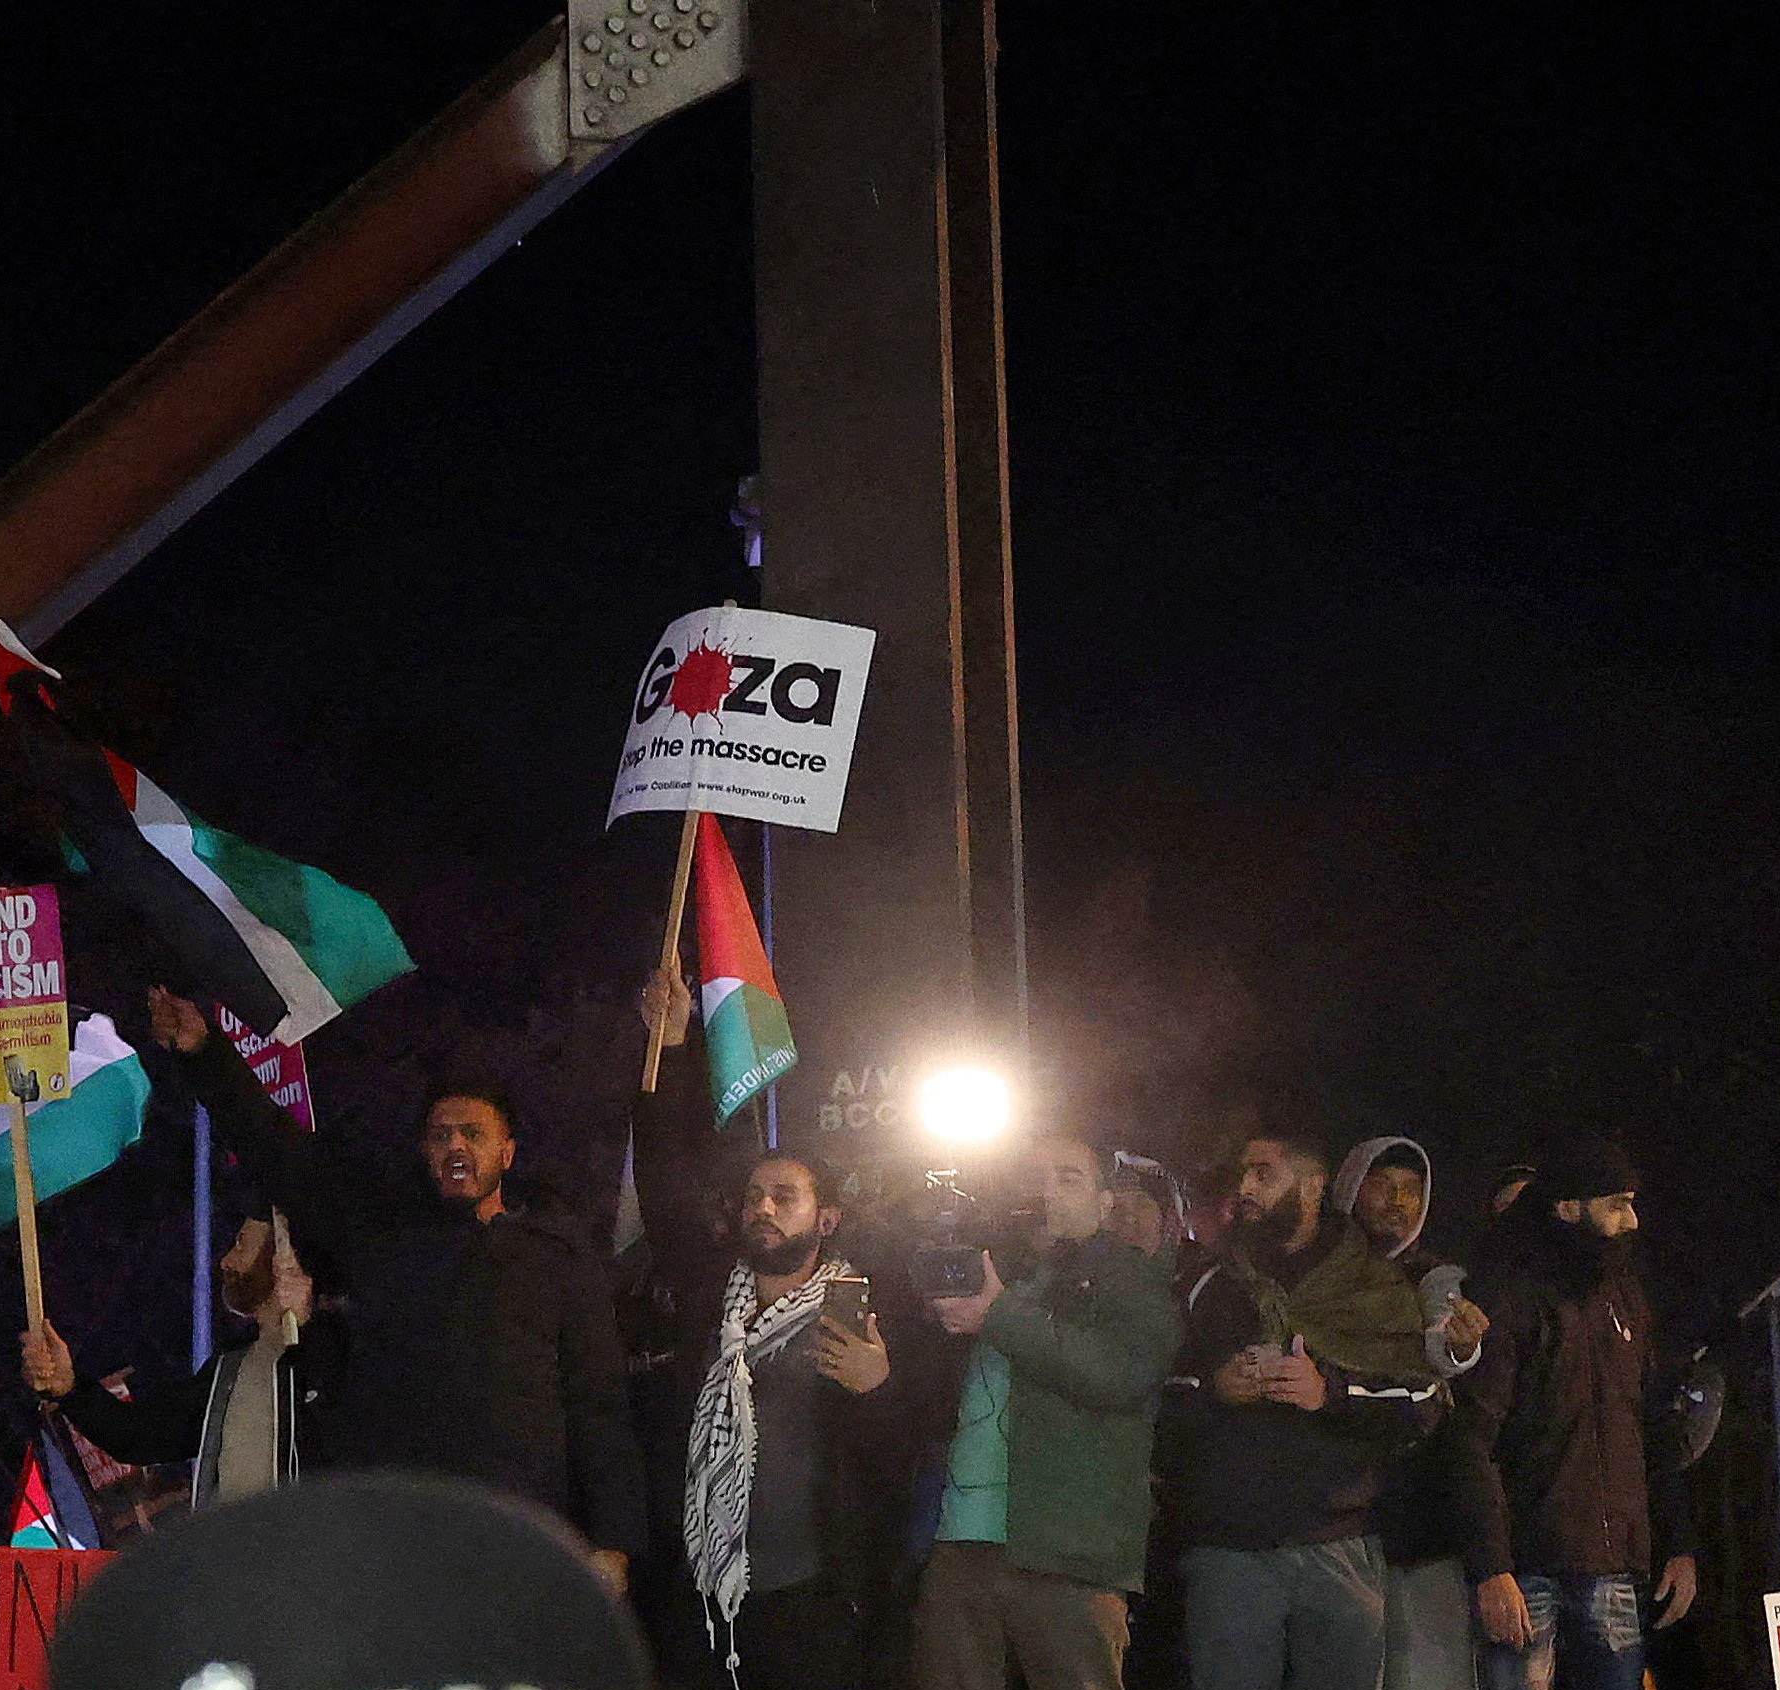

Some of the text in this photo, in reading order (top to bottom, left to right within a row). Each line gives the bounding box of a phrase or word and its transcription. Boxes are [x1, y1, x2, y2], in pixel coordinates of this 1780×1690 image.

[636, 646, 842, 727] Gza
[650, 736, 685, 760] the
[690, 738, 827, 773] massacre
